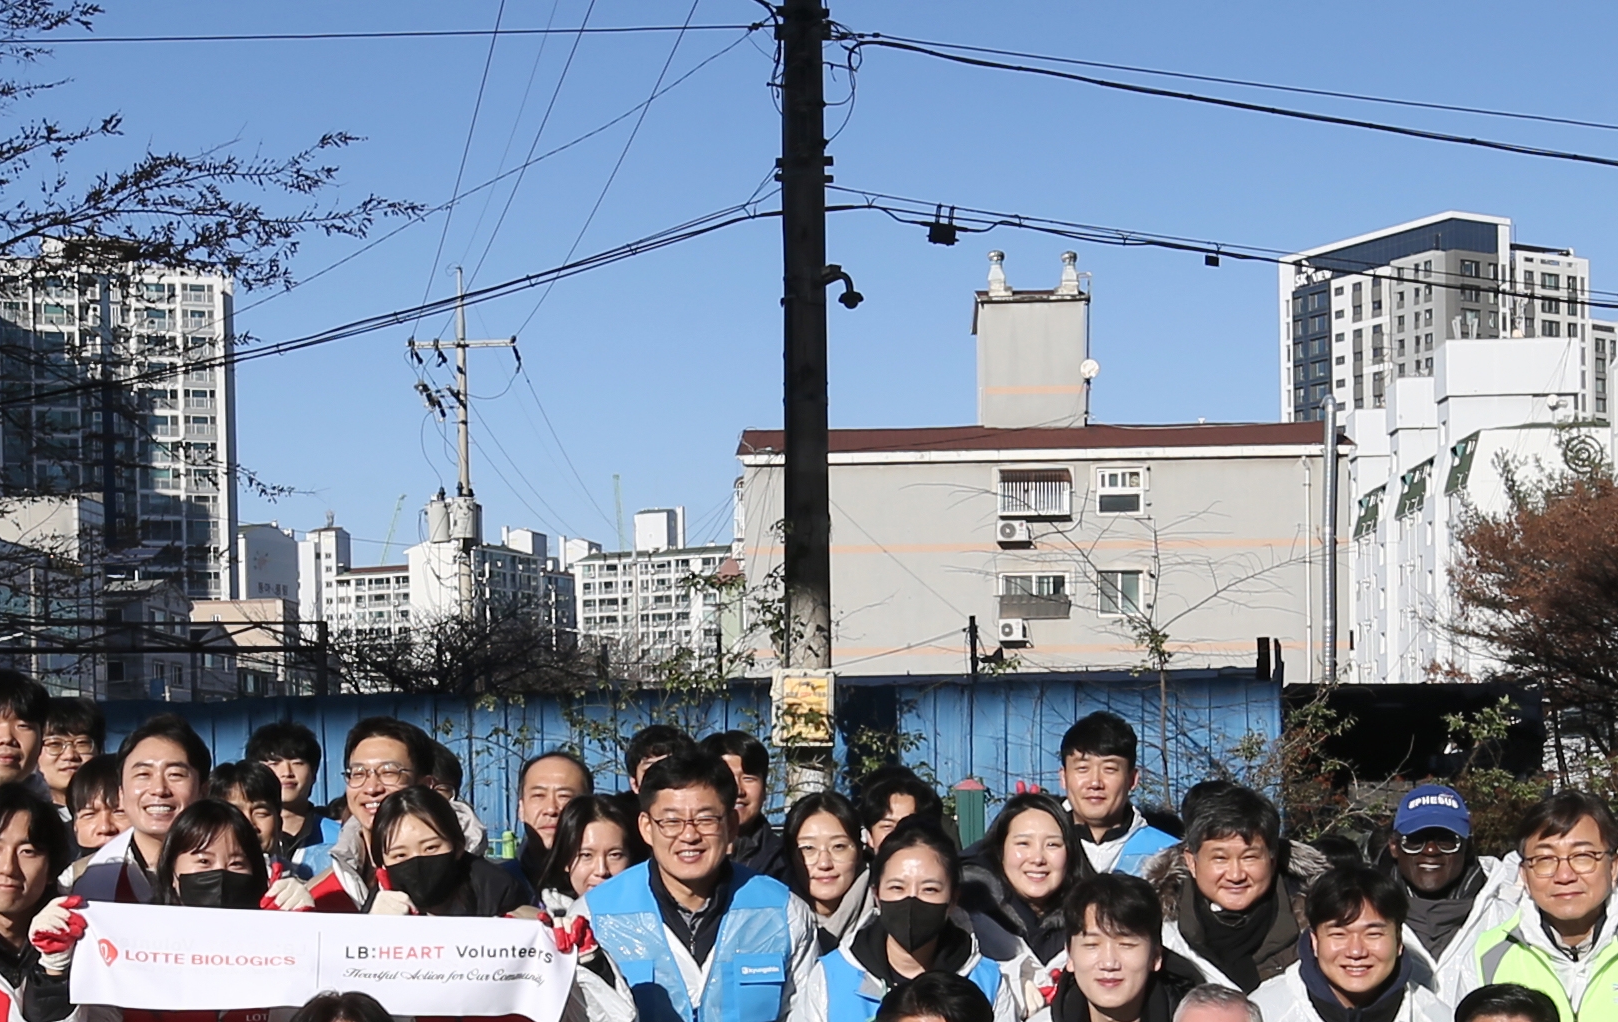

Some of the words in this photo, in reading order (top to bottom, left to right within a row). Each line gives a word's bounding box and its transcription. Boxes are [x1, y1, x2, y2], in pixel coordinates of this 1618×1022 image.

[125, 950, 185, 965] LOTTE
[191, 954, 296, 966] BIOLOGICS
[345, 945, 445, 960] LB:HEART
[456, 944, 553, 964] Volunteers
[400, 968, 443, 981] Action
[442, 971, 464, 983] for
[466, 968, 490, 981] Our
